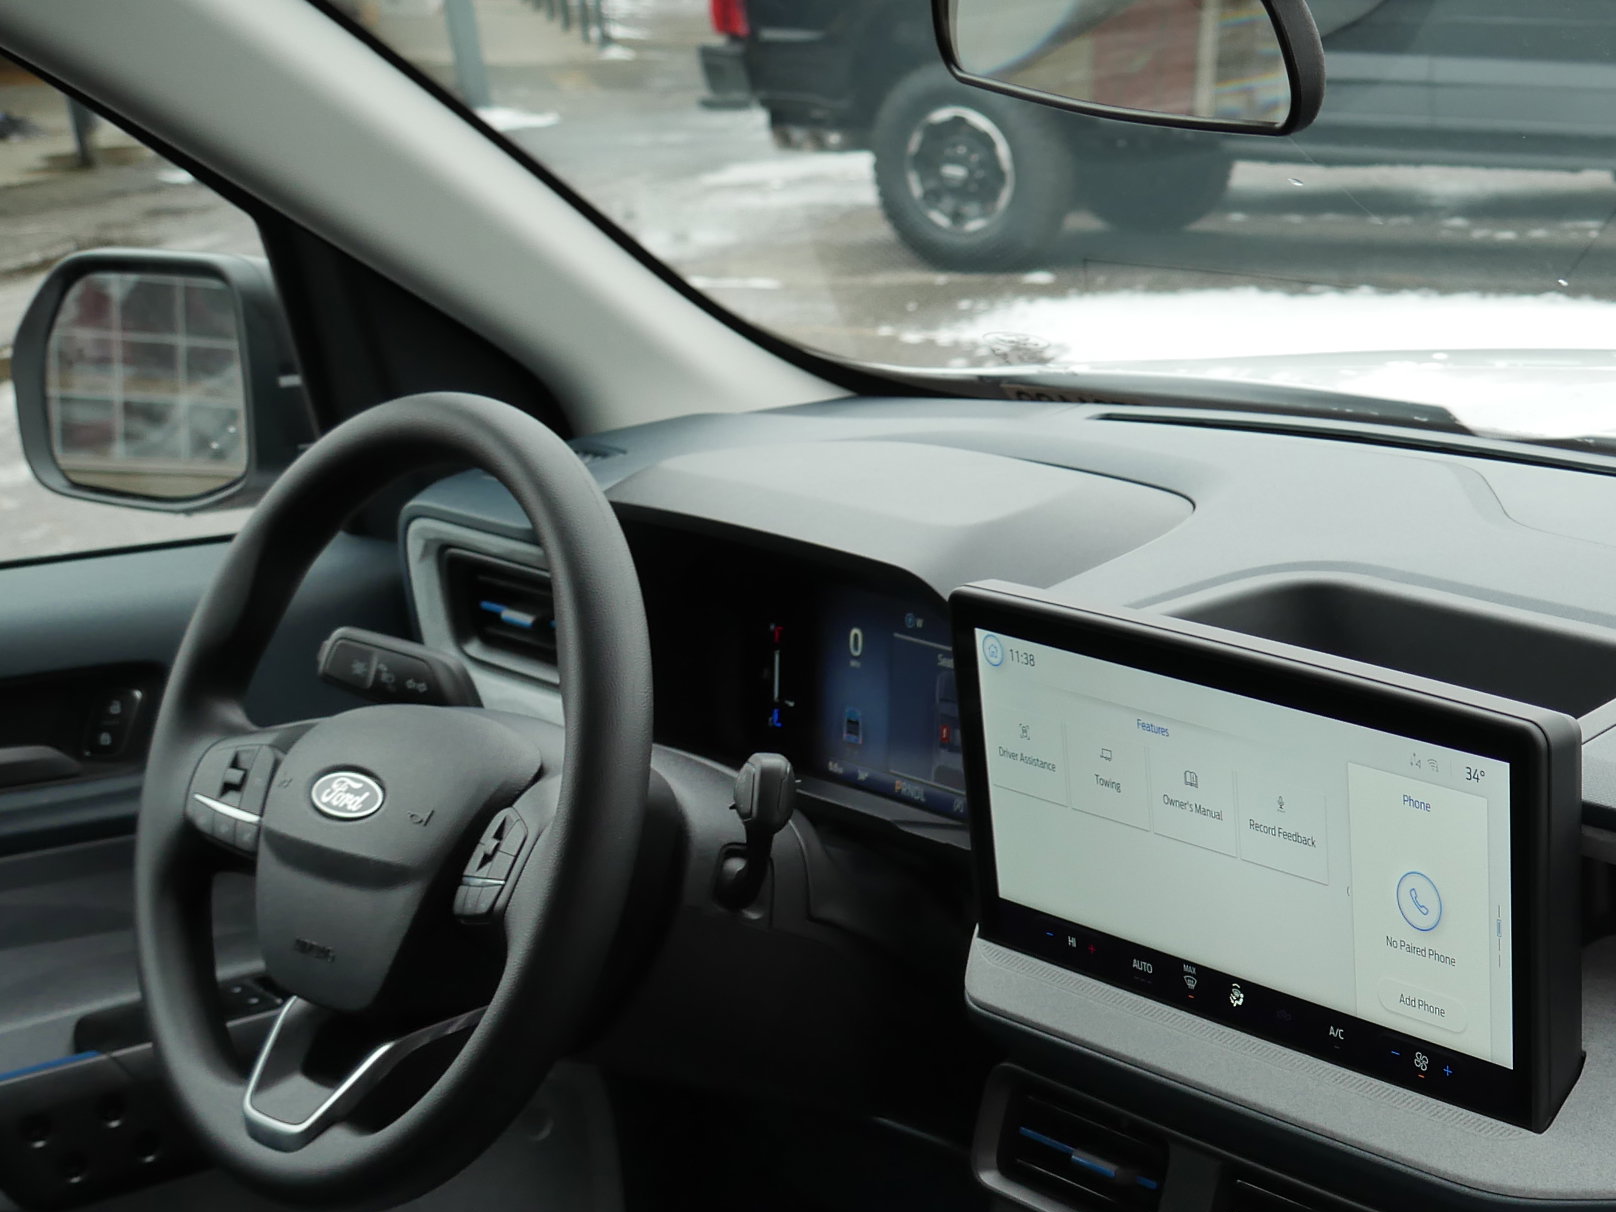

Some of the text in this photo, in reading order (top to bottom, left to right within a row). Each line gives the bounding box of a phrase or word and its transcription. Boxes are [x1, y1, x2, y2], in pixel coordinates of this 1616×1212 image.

[849, 627, 863, 657] 0
[1009, 649, 1036, 667] 11:38
[1136, 718, 1170, 737] Features
[998, 746, 1056, 773] Driver Assistance
[1094, 774, 1121, 793] Towing
[1465, 766, 1486, 783] 34°
[320, 776, 371, 812] Ford
[1402, 794, 1431, 812] Phone
[1162, 794, 1223, 821] Owner's Manual
[1249, 819, 1316, 848] Record Feedback
[1068, 936, 1077, 948] HI
[1386, 936, 1456, 967] No Paired Phone
[1132, 958, 1153, 974] AUTO
[1183, 964, 1197, 975] MAX
[1400, 994, 1446, 1017] Add Phone
[1329, 1025, 1345, 1040] A/C
